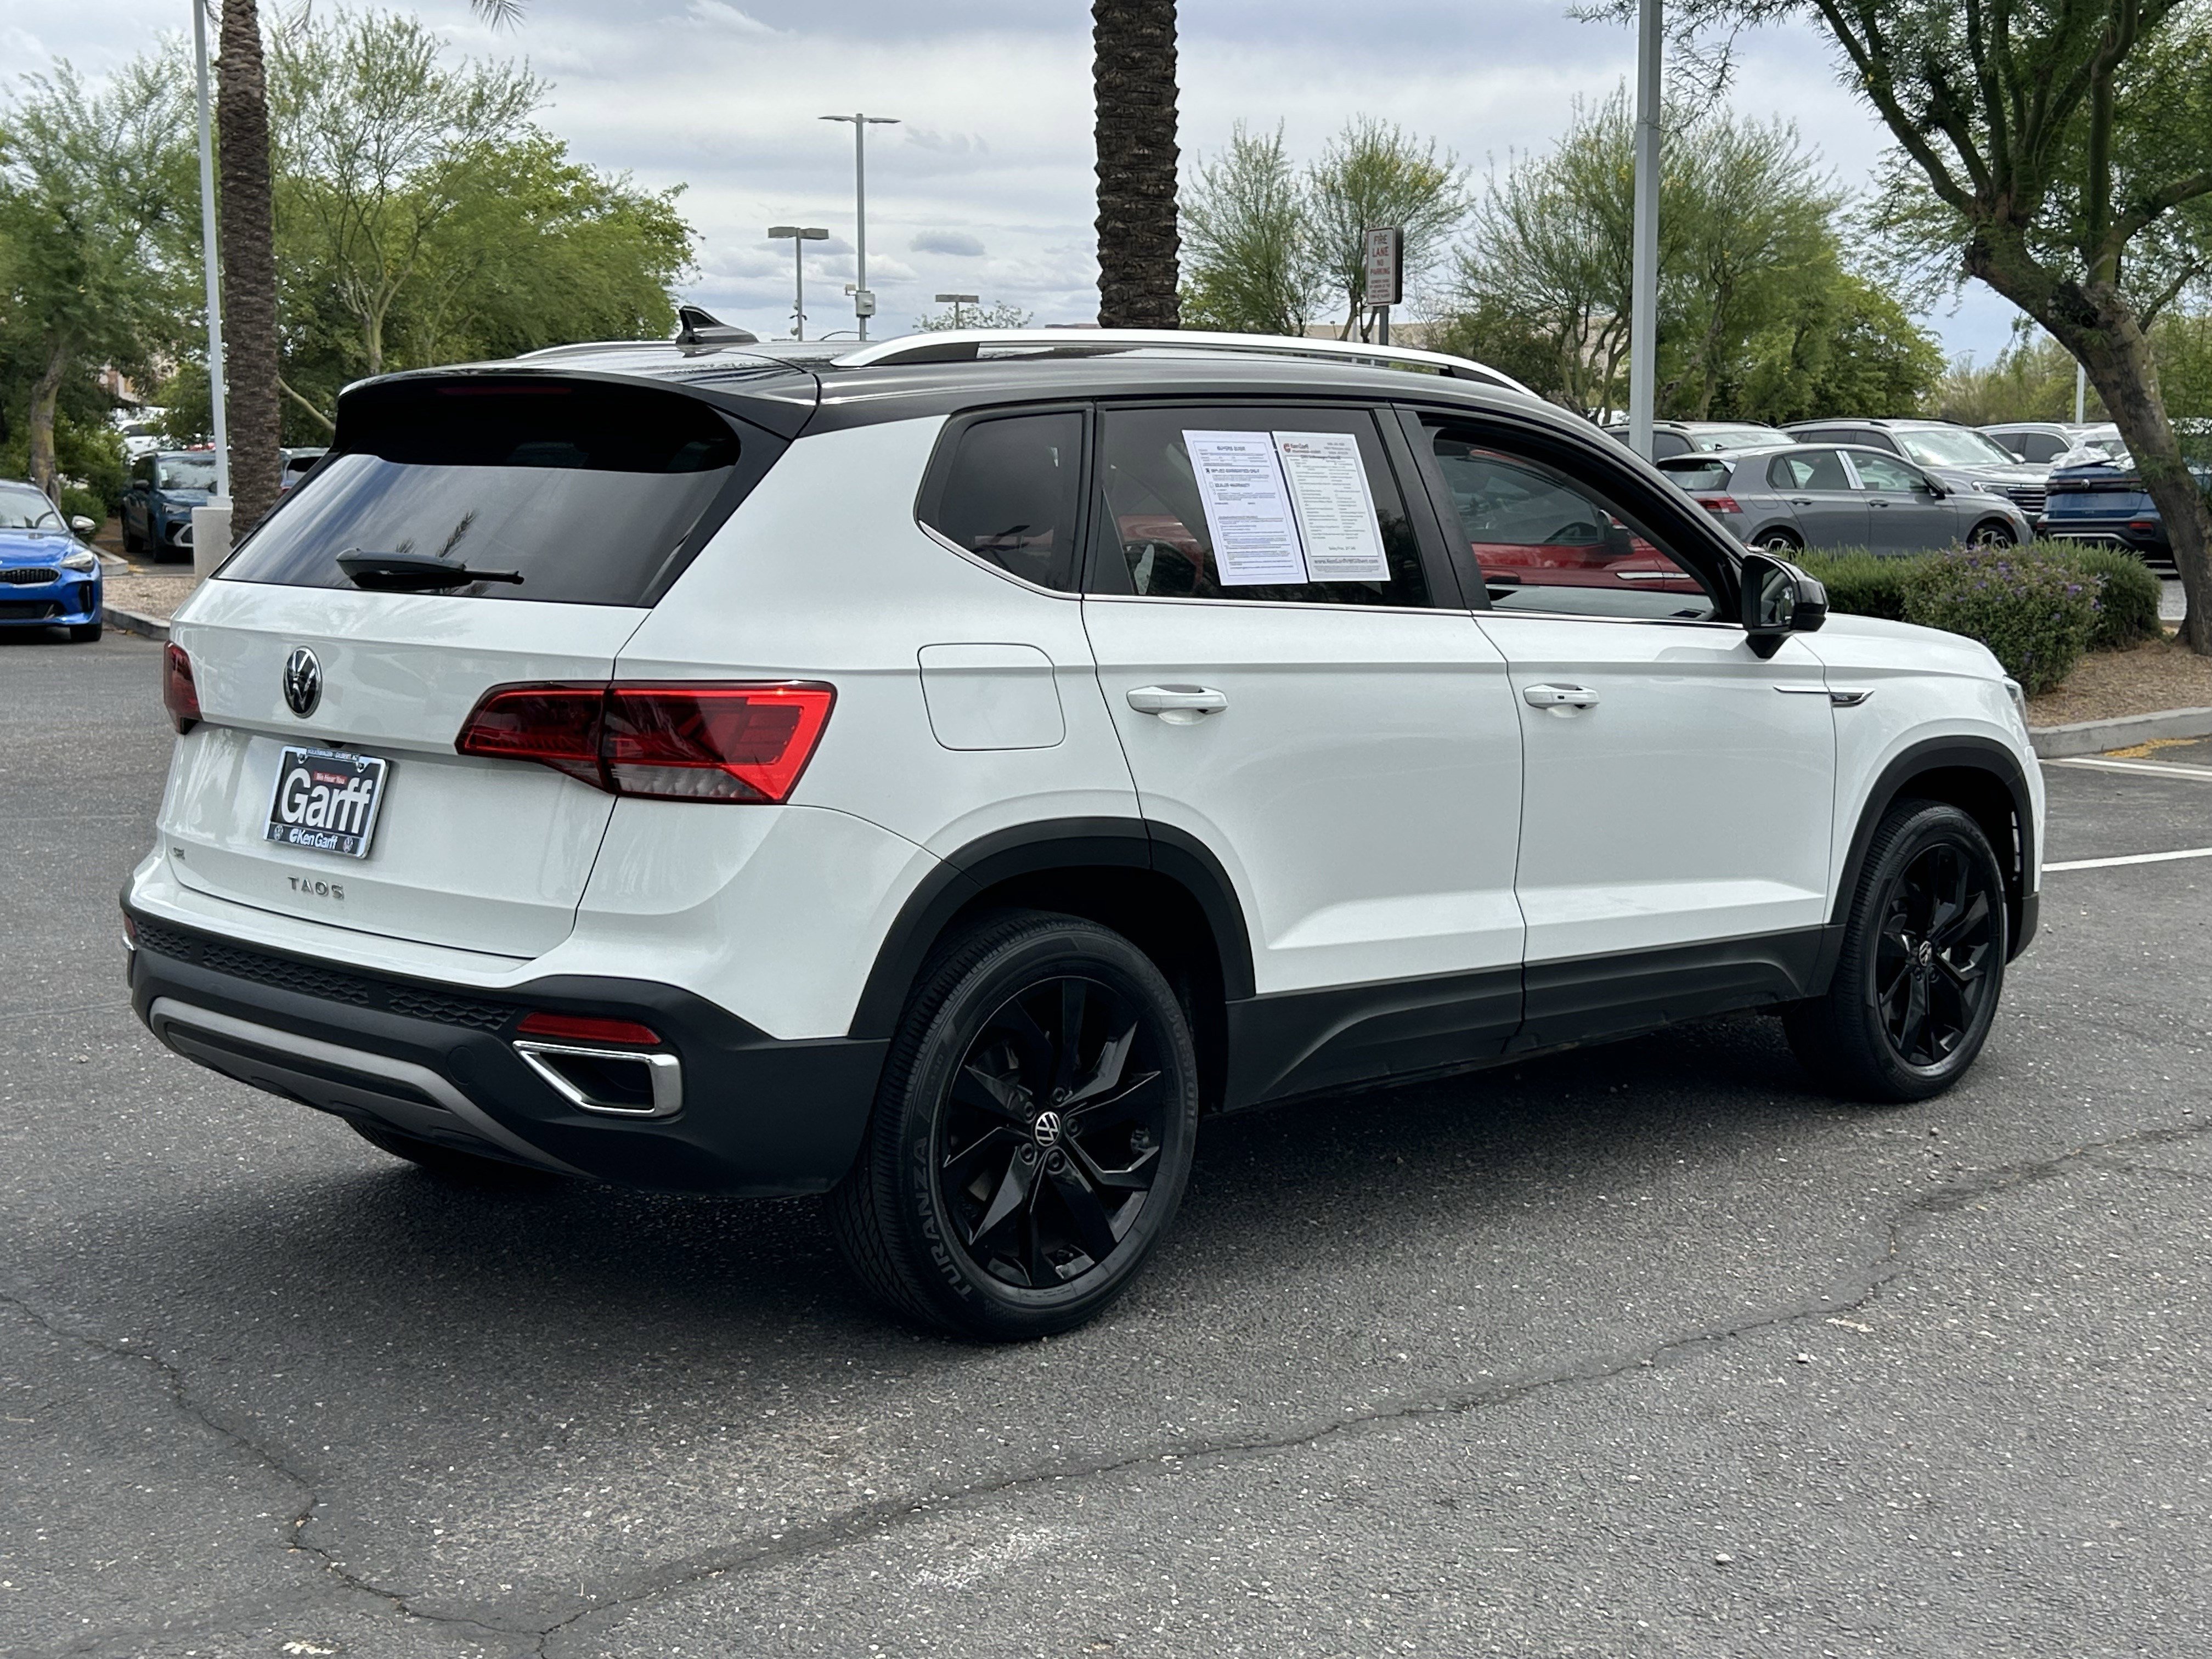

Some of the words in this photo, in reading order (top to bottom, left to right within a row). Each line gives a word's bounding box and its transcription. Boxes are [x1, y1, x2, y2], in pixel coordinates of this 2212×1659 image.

[1372, 246, 1389, 257] LANE
[281, 768, 373, 834] Garff
[296, 829, 315, 845] Ken
[314, 832, 338, 850] Garff
[287, 876, 345, 900] TAOS
[913, 1137, 973, 1302] TURANZA
